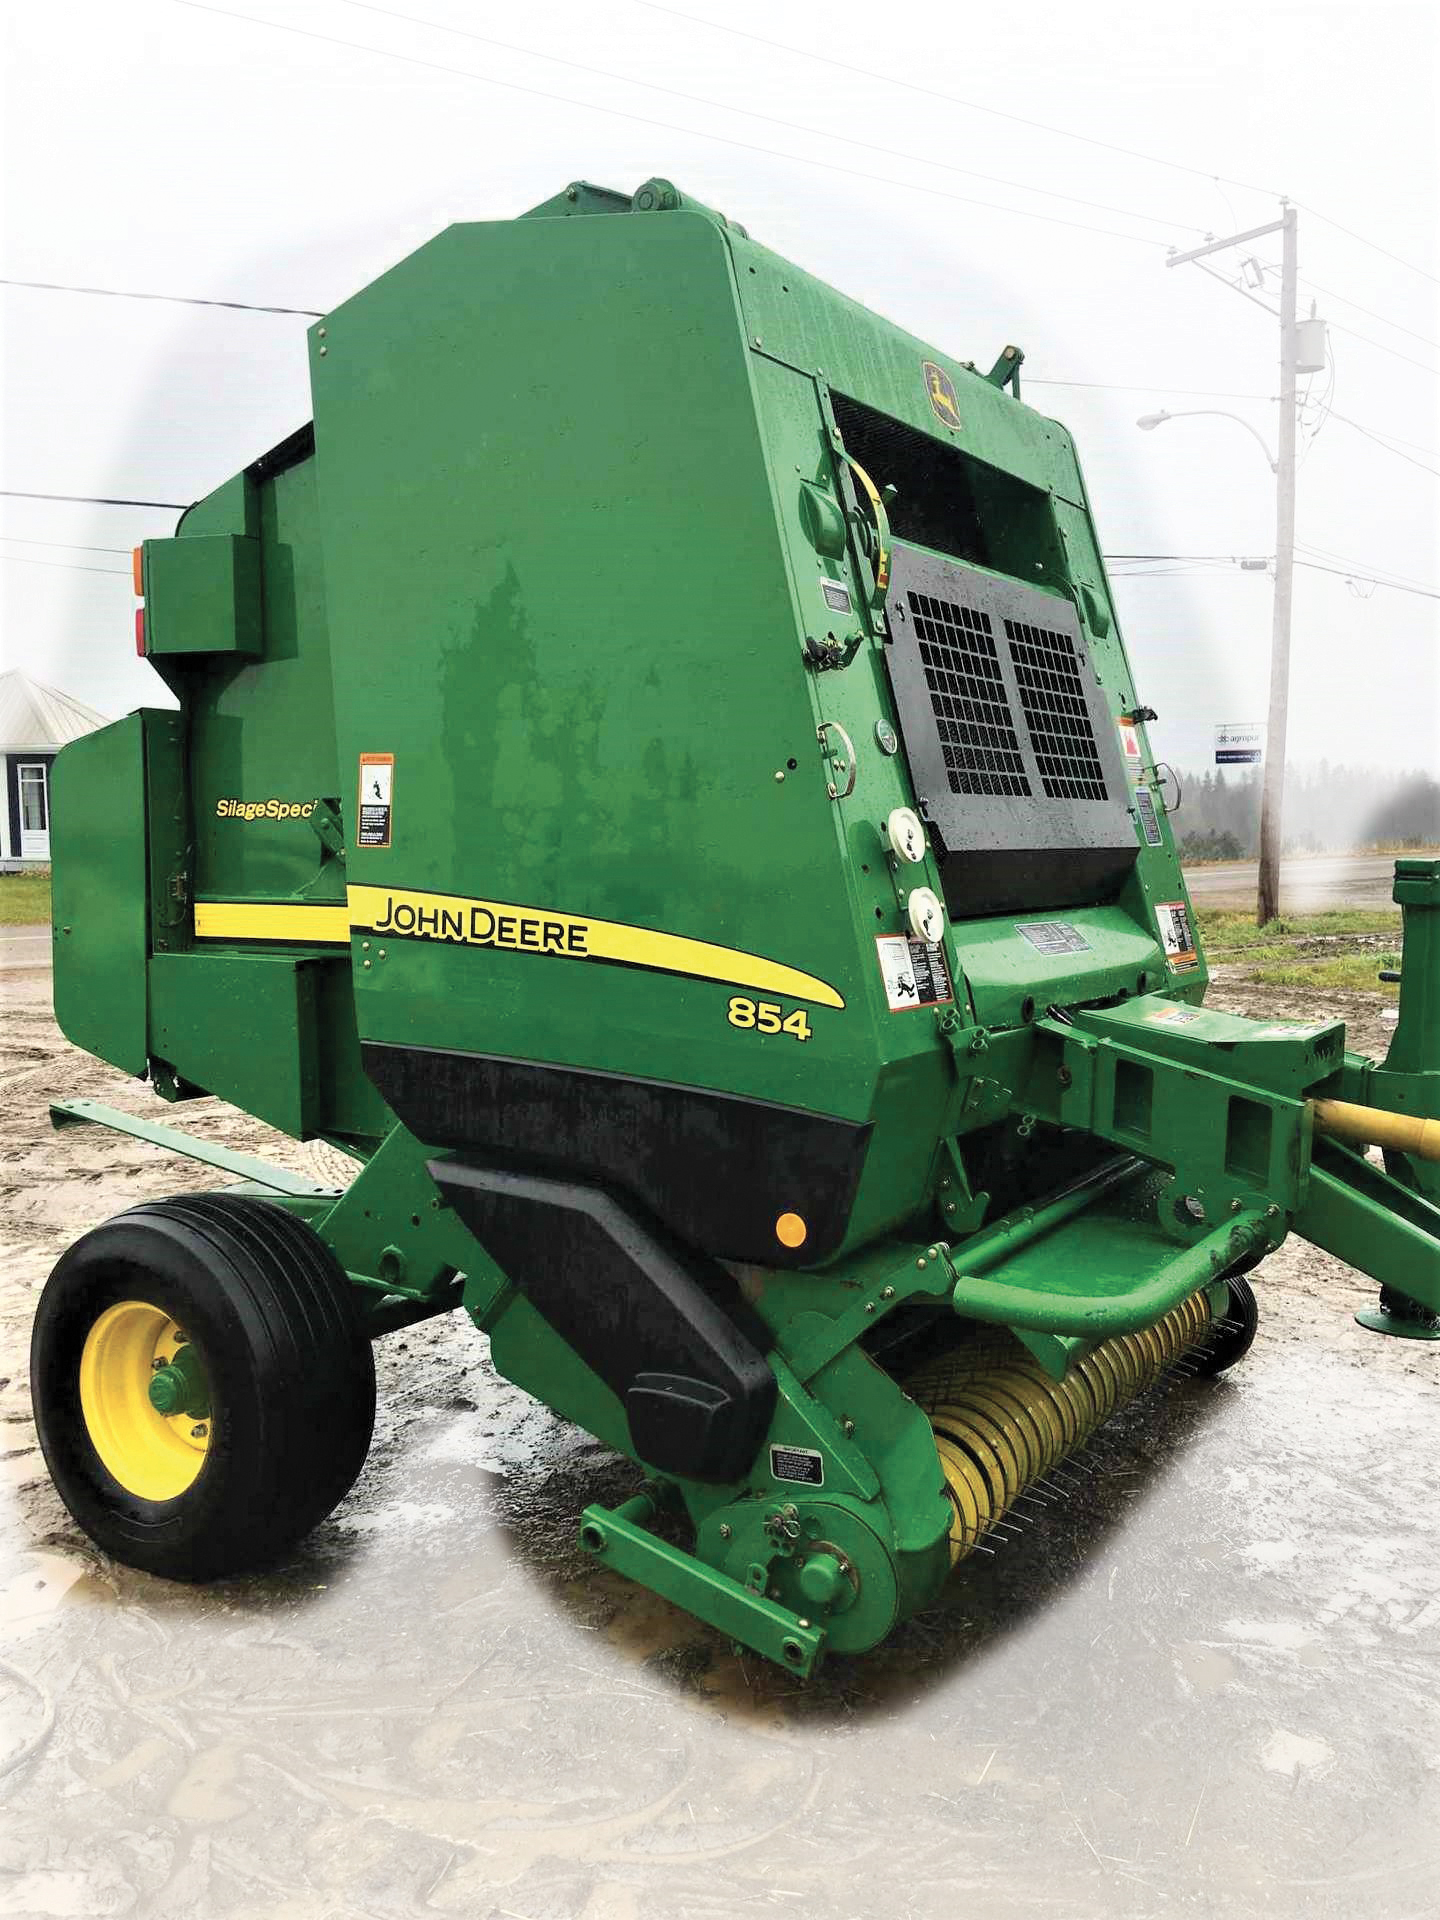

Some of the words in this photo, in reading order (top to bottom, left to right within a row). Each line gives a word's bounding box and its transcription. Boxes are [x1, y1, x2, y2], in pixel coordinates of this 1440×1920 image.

[375, 897, 464, 938] JOHN
[469, 907, 588, 953] DEERE
[727, 995, 813, 1042] 854
